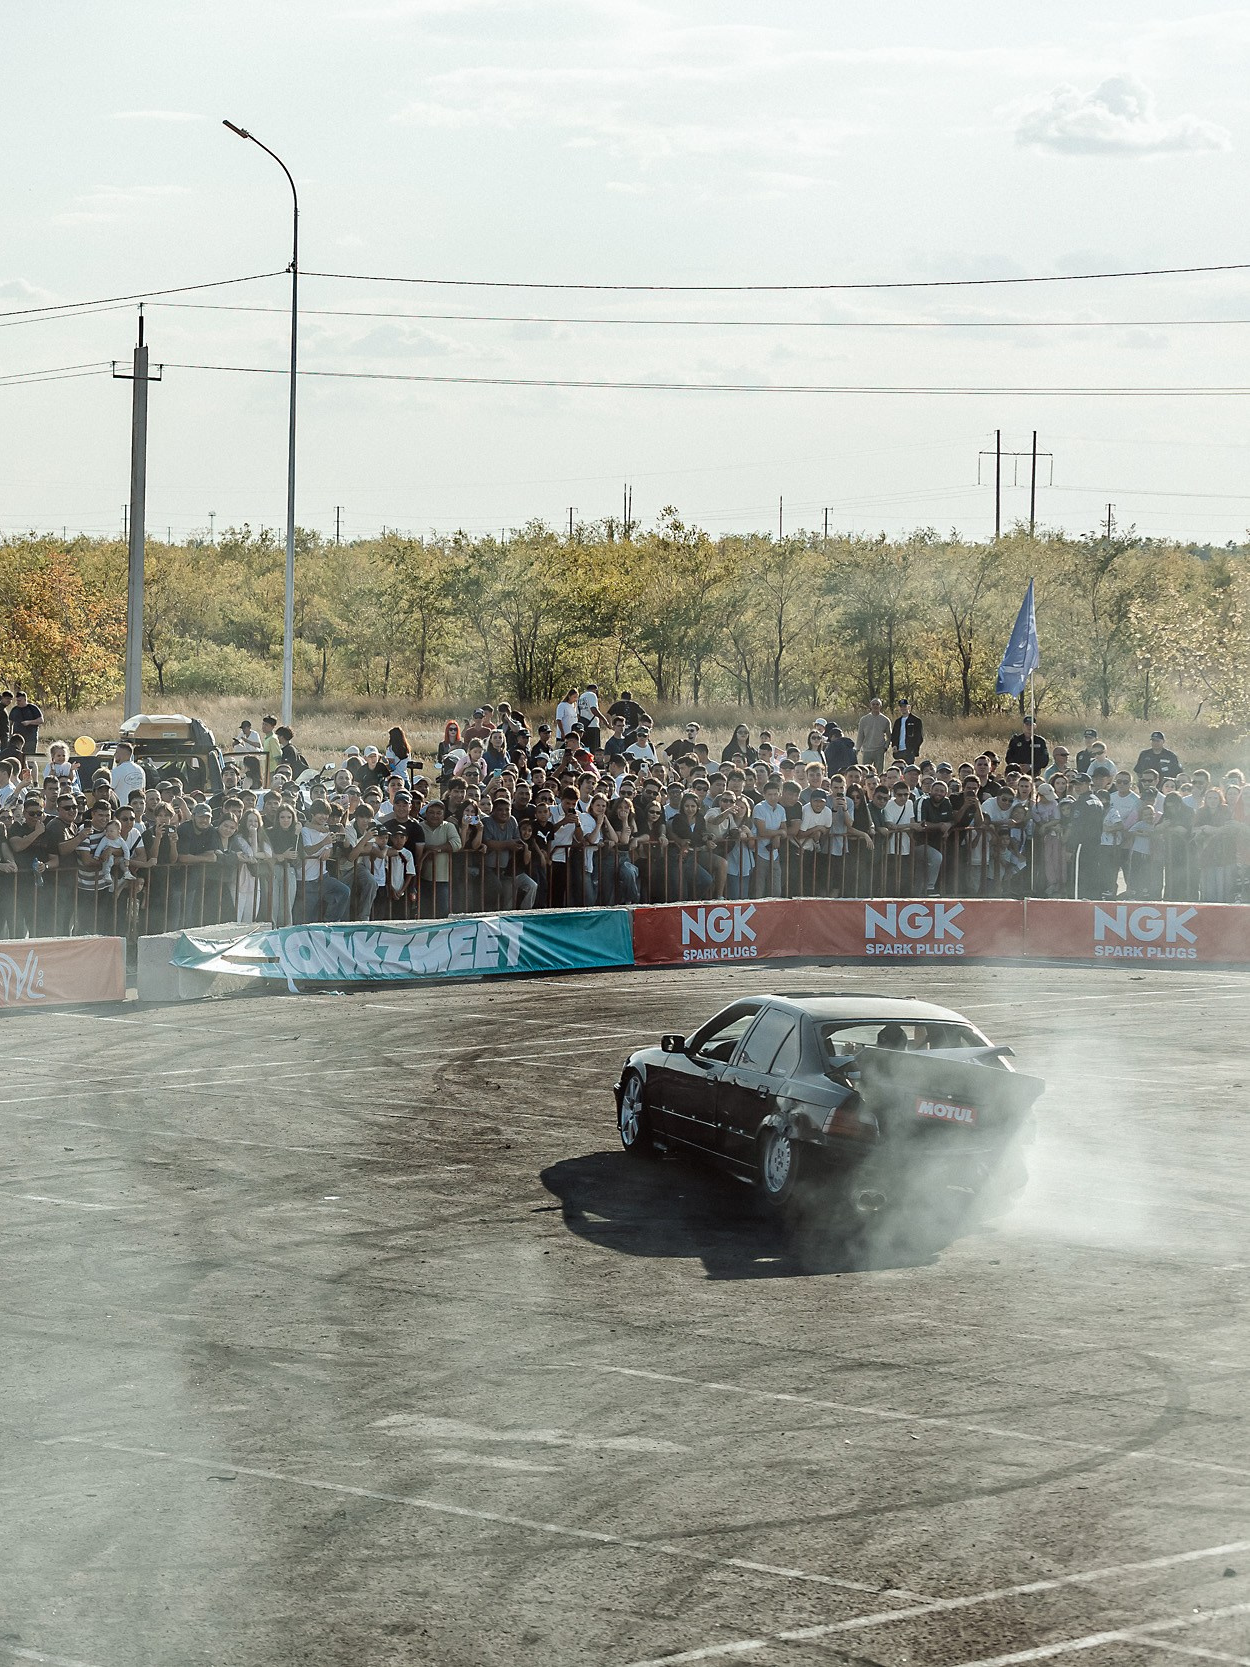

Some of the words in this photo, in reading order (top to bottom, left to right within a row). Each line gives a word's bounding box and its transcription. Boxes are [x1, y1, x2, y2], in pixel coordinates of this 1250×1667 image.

[681, 903, 758, 945] NGK
[865, 902, 966, 941] NGK
[1093, 905, 1199, 944] NGK
[683, 949, 719, 961] SPARK
[720, 945, 758, 959] PLUGS
[865, 943, 913, 955] SPARK
[916, 943, 965, 955] PLUGS
[1094, 945, 1144, 958] SPARK
[1147, 946, 1198, 959] PLUGS
[918, 1101, 974, 1123] MOTUL
